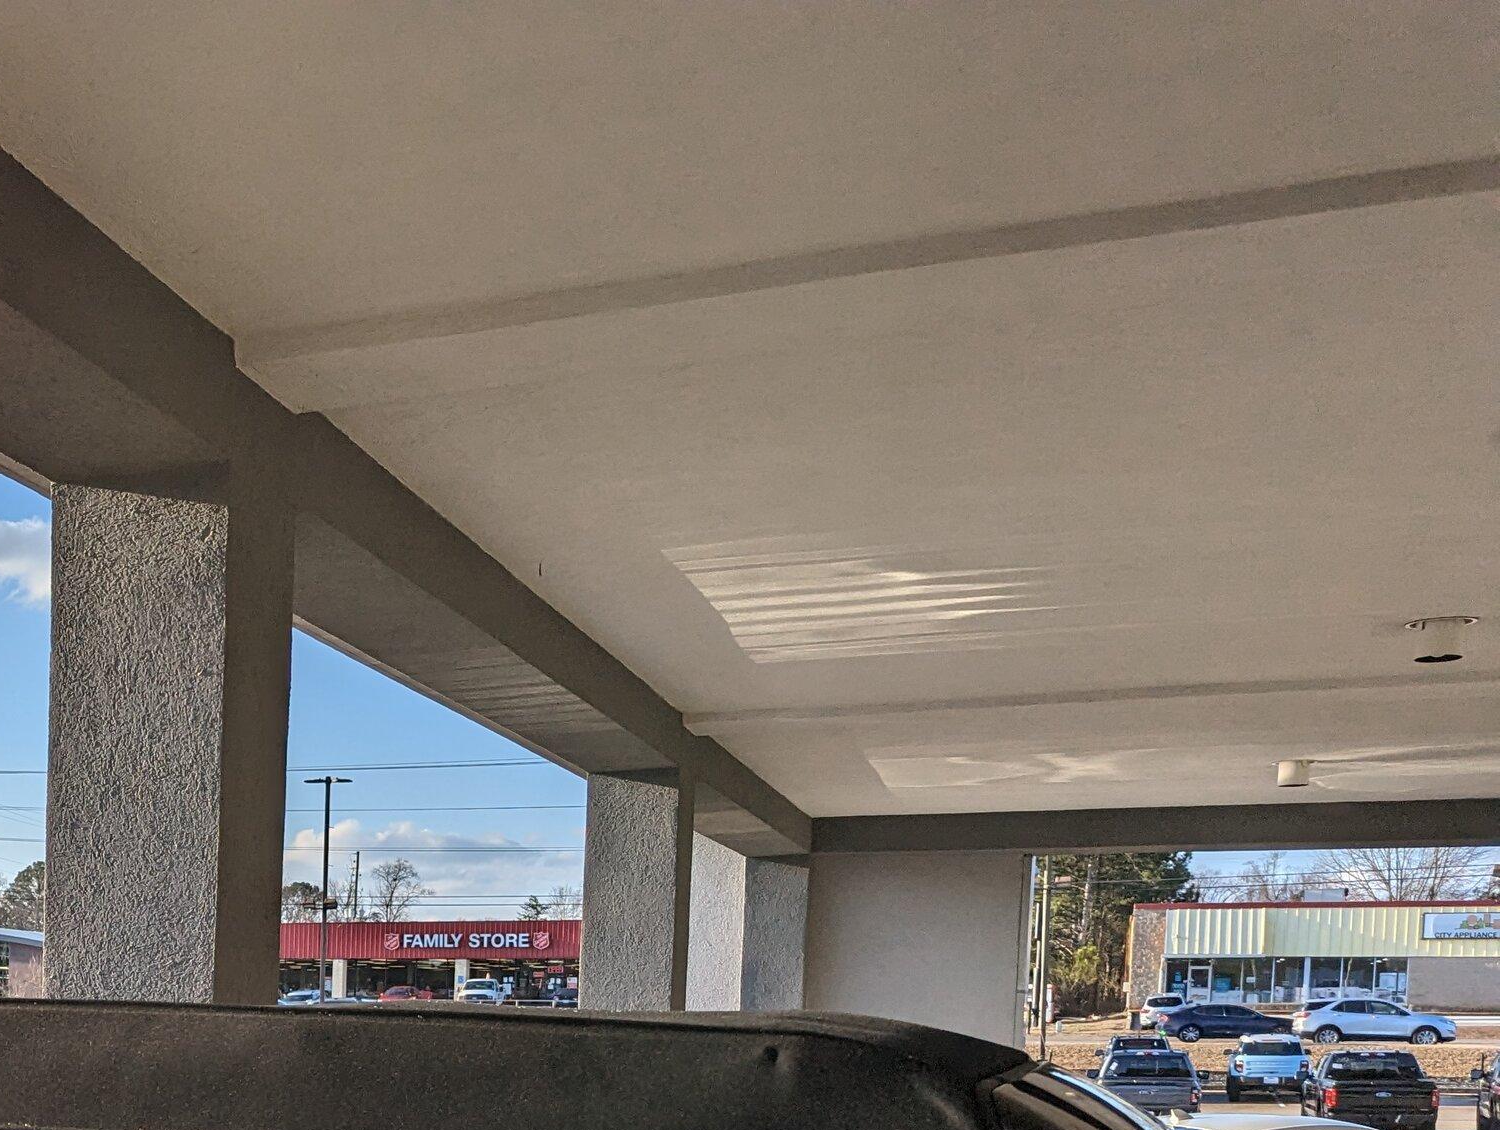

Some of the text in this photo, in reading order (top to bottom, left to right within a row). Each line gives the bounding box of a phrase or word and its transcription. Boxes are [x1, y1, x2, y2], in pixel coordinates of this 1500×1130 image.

[402, 933, 463, 948] FAMILY
[468, 933, 530, 948] STORE
[1454, 931, 1497, 939] APPLIANCE
